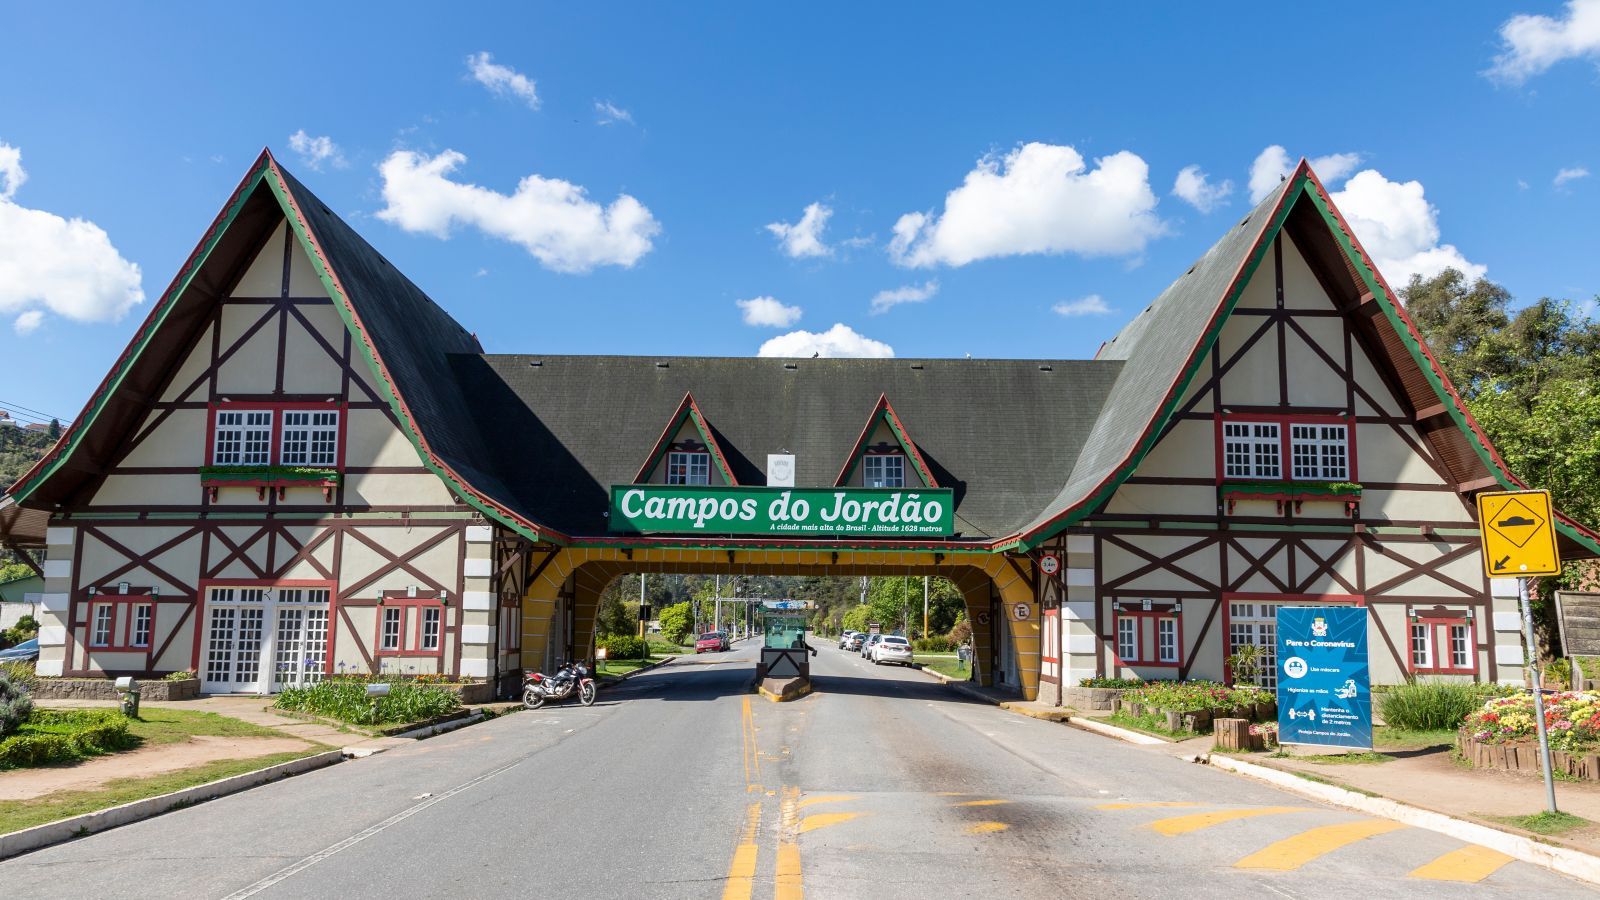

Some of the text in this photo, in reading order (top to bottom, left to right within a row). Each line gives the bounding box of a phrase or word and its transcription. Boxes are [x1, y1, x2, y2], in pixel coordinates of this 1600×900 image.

[621, 489, 943, 528] Campos do Jordão
[846, 524, 867, 532] Brasil
[1310, 640, 1355, 648] Coronavírus
